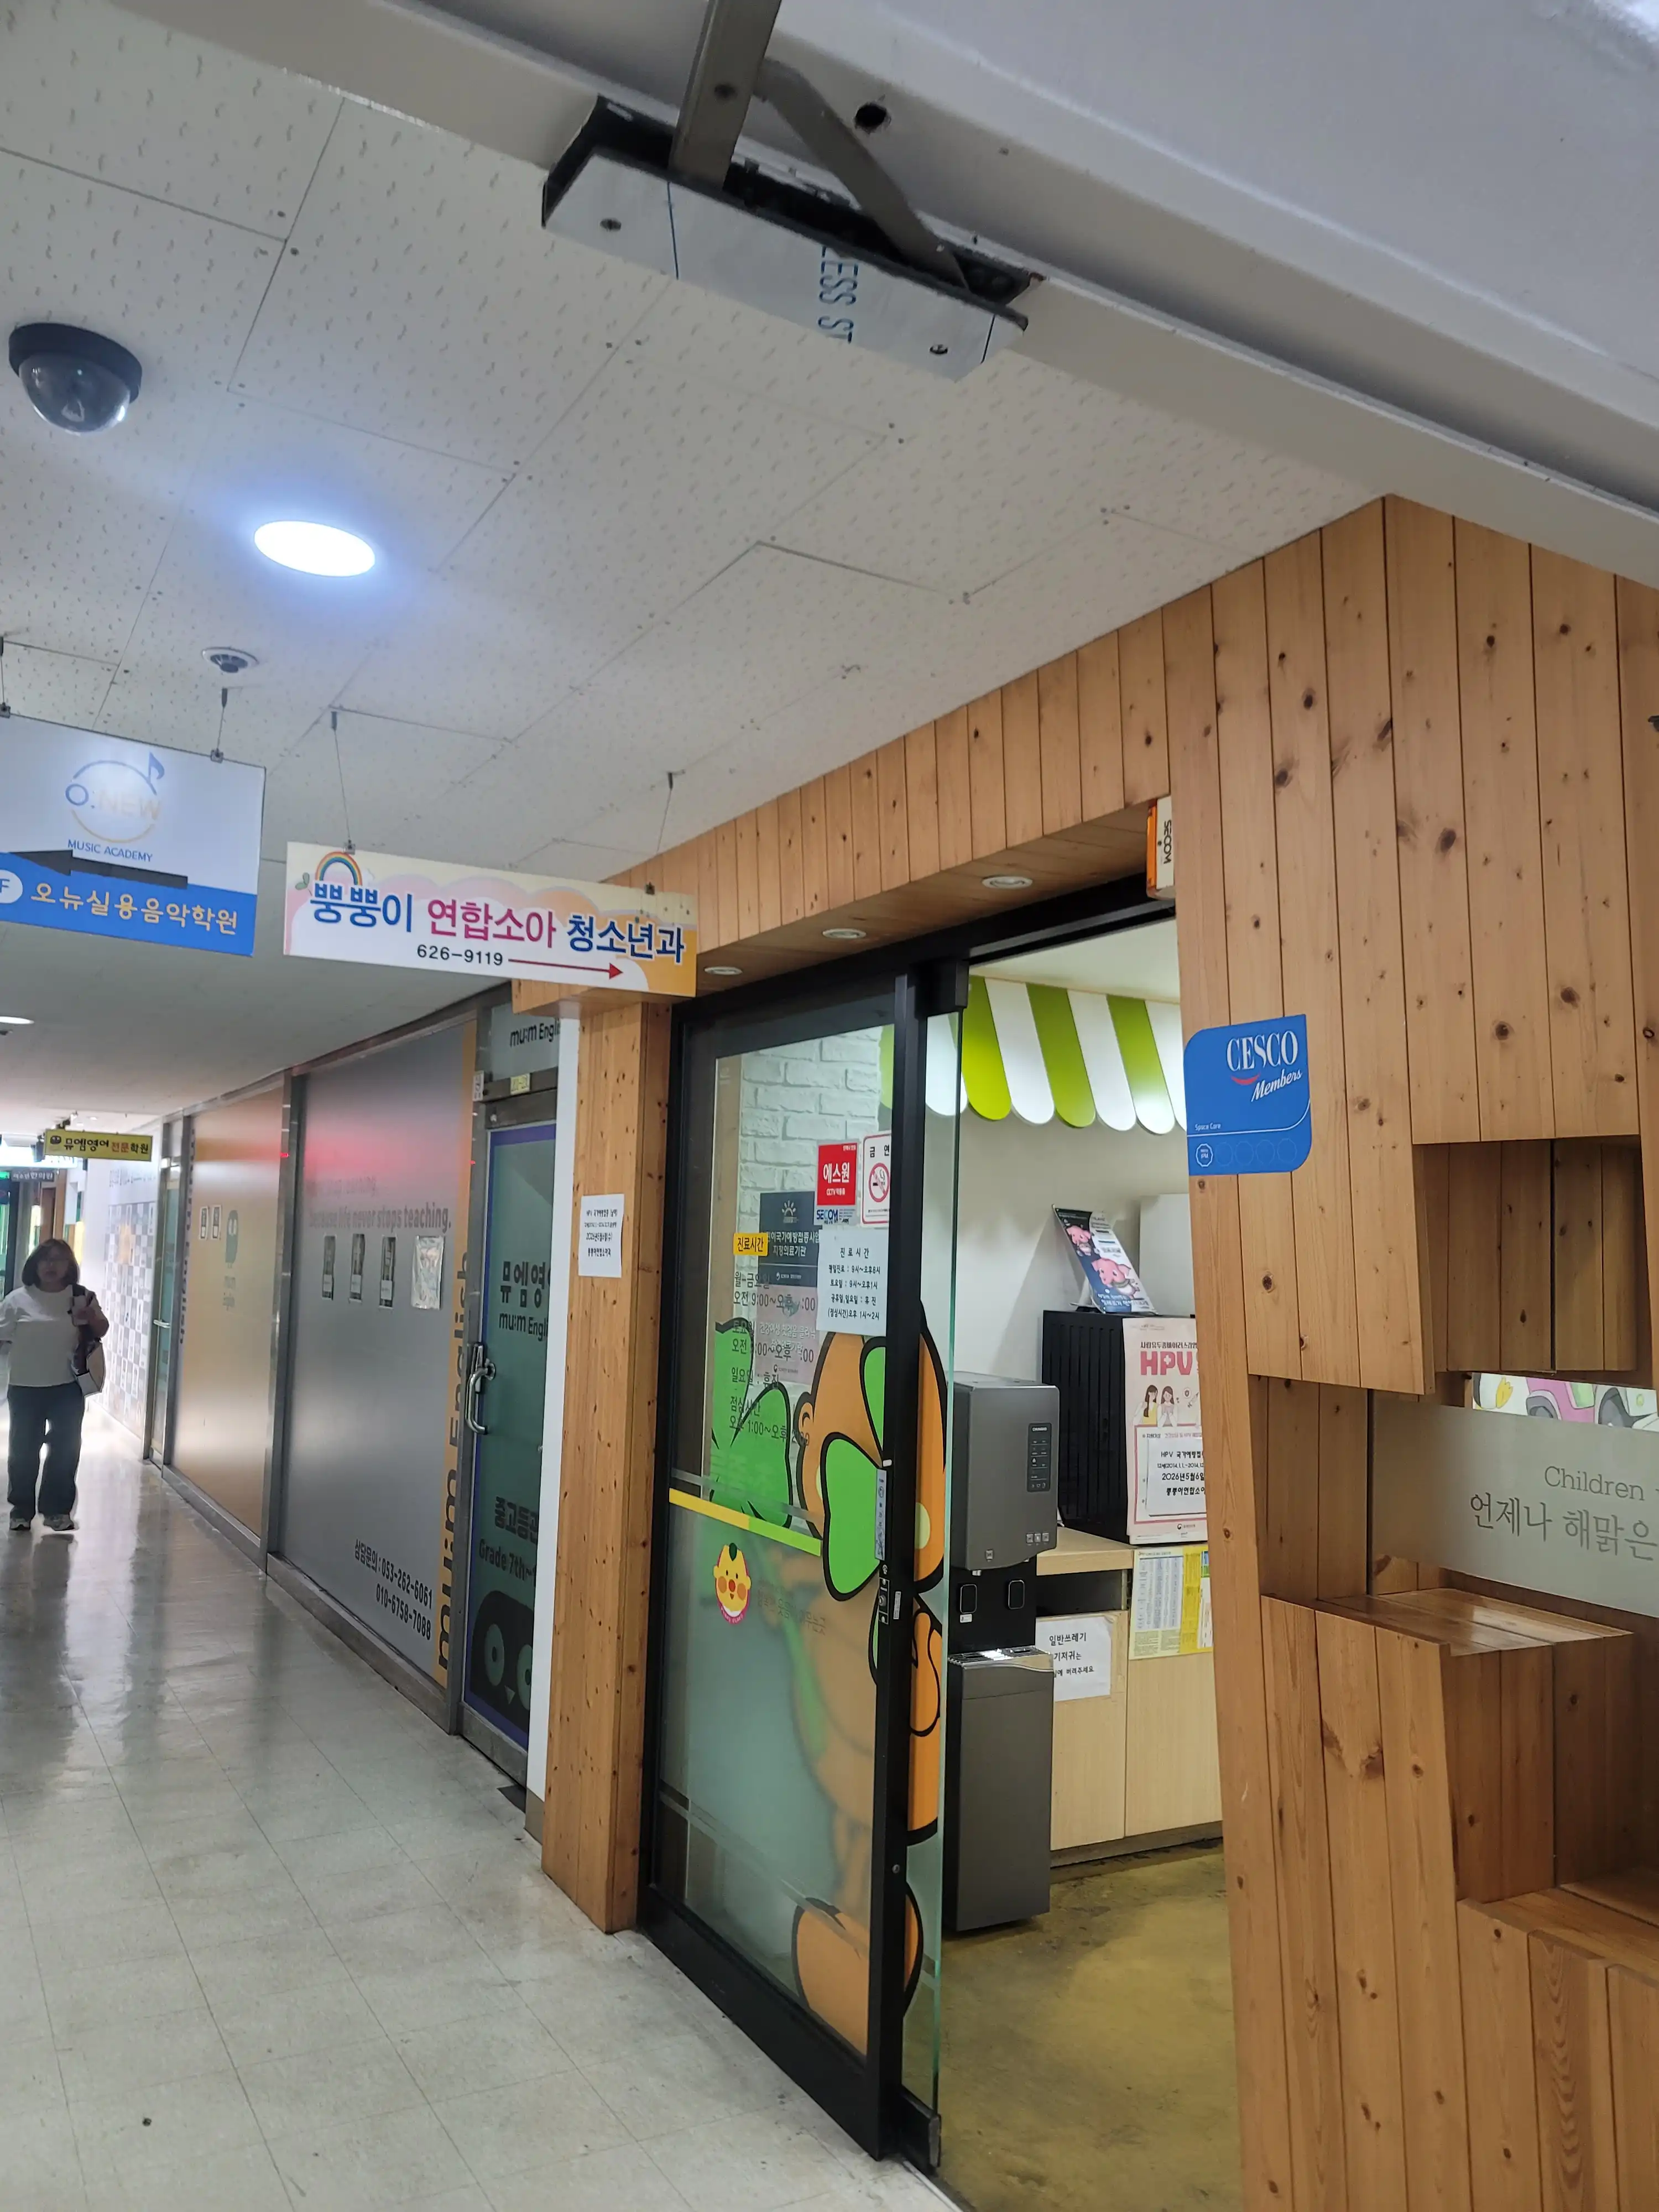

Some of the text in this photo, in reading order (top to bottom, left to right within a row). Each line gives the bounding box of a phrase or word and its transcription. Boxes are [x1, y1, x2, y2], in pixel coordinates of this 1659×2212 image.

[819, 247, 858, 305] ESS
[67, 839, 153, 862] MUSIC ACADEMY
[1164, 820, 1172, 864] SECOM
[30, 883, 238, 935] 오뉴실용음악학원
[310, 881, 686, 963] 뿡뿡이 연합소아 청소년과
[416, 943, 504, 966] 626-9119
[1227, 1030, 1298, 1072] CESCO
[1251, 1068, 1303, 1102] Members
[823, 1162, 850, 1184] 에스원
[377, 1204, 403, 1234] stops
[404, 1201, 452, 1234] teaching.
[816, 1209, 838, 1220] SECOM
[737, 1238, 764, 1253] 진료시간
[767, 1231, 820, 1244] 이국가예방접종사업
[773, 1245, 806, 1257] 지정의료기관
[830, 1279, 843, 1288] 토요일
[733, 1291, 748, 1306] 오전
[732, 1338, 747, 1354] 오전
[1140, 1350, 1193, 1376] HPV
[731, 1366, 753, 1386] 일요일
[1544, 1465, 1645, 1501] Children
[1470, 1492, 1658, 1561] 언제나 해맑은
[479, 1538, 507, 1572] Grade
[376, 1583, 431, 1641] 010-6758-7088
[1049, 1632, 1086, 1646] 일반쓰레기
[1053, 1650, 1082, 1662] 기저귀는
[1066, 1665, 1094, 1676] 버려주세요
